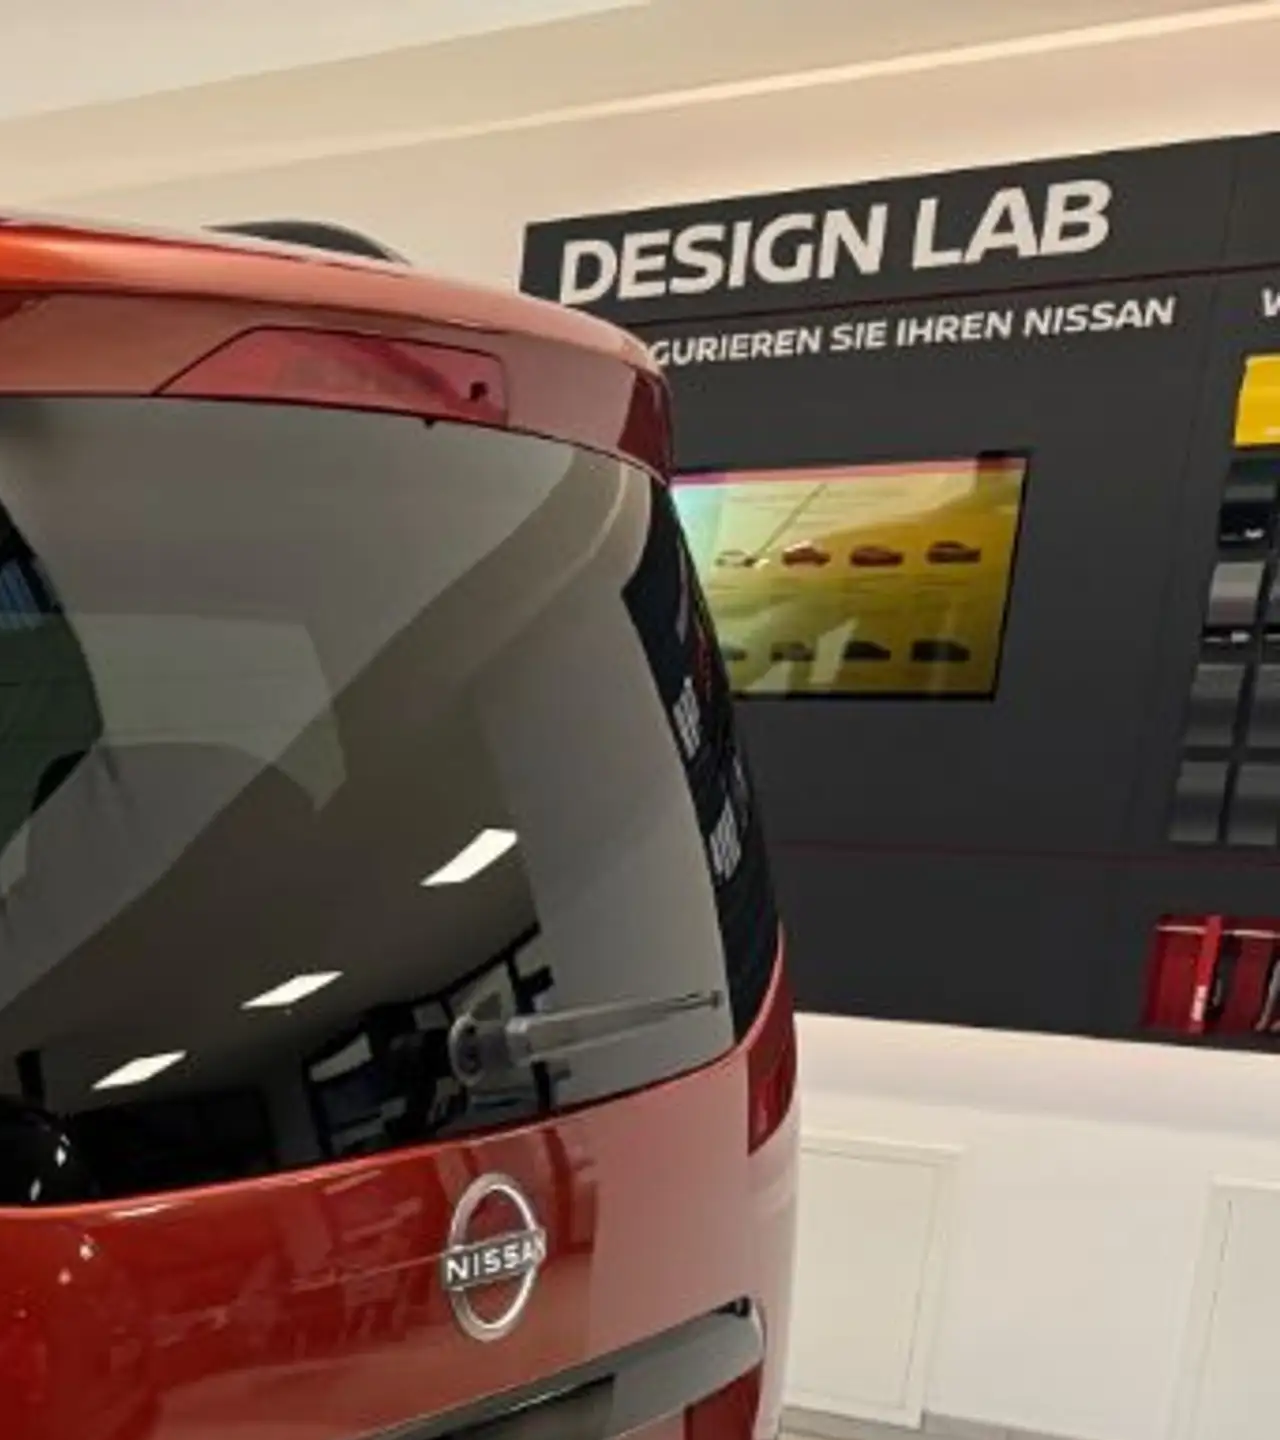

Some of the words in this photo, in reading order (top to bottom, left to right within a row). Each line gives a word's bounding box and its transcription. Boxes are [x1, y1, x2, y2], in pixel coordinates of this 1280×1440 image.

[559, 204, 887, 305] DESIGN
[912, 179, 1111, 270] LAB
[650, 326, 823, 366] GURIEREN
[830, 321, 887, 351] SIE
[897, 311, 1012, 346] IHREN
[1022, 297, 1175, 337] NISSAN
[445, 1241, 533, 1283] NISSA
